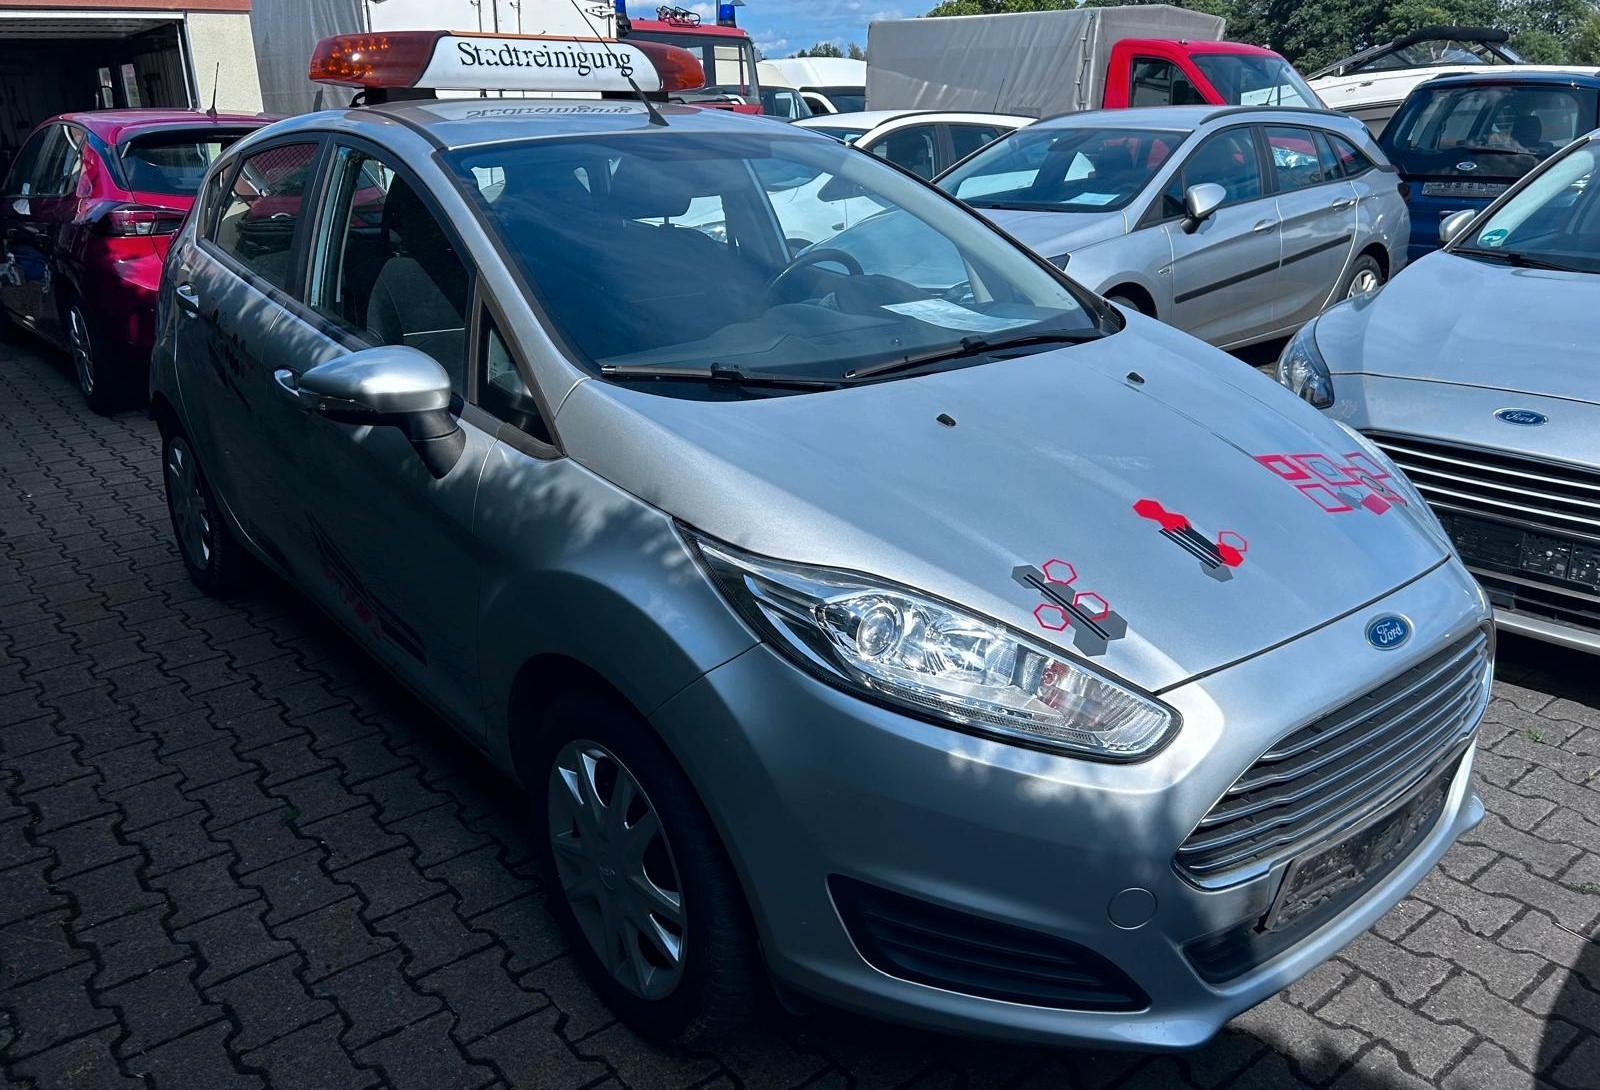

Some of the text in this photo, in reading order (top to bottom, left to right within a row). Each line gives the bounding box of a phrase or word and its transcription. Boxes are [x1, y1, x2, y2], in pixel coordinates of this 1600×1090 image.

[457, 41, 634, 78] Stadtreinigung
[1505, 411, 1536, 423] Ford
[1376, 621, 1404, 644] Ford
